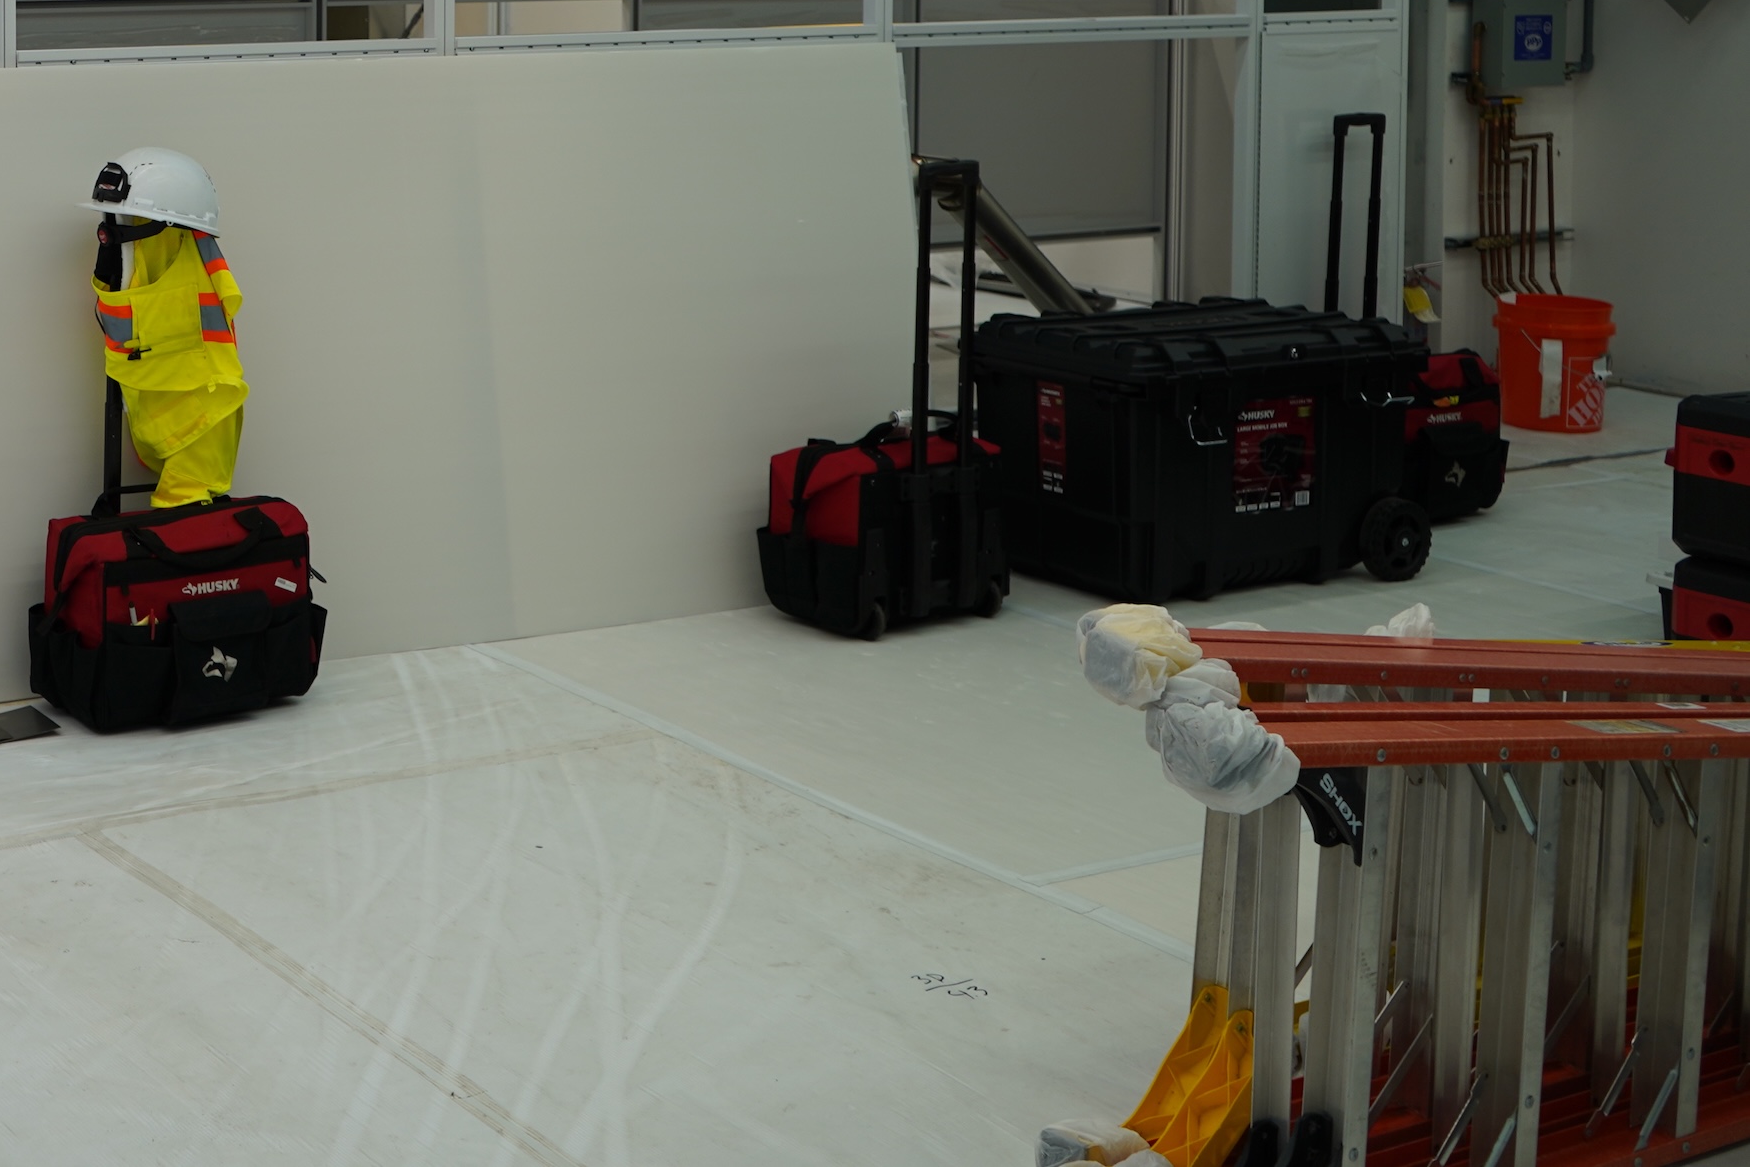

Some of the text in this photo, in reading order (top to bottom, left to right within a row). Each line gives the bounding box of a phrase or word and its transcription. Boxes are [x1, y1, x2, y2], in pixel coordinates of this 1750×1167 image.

[1247, 409, 1275, 421] HUSKY
[197, 578, 239, 594] HUSKY
[1319, 773, 1363, 836] SHOX
